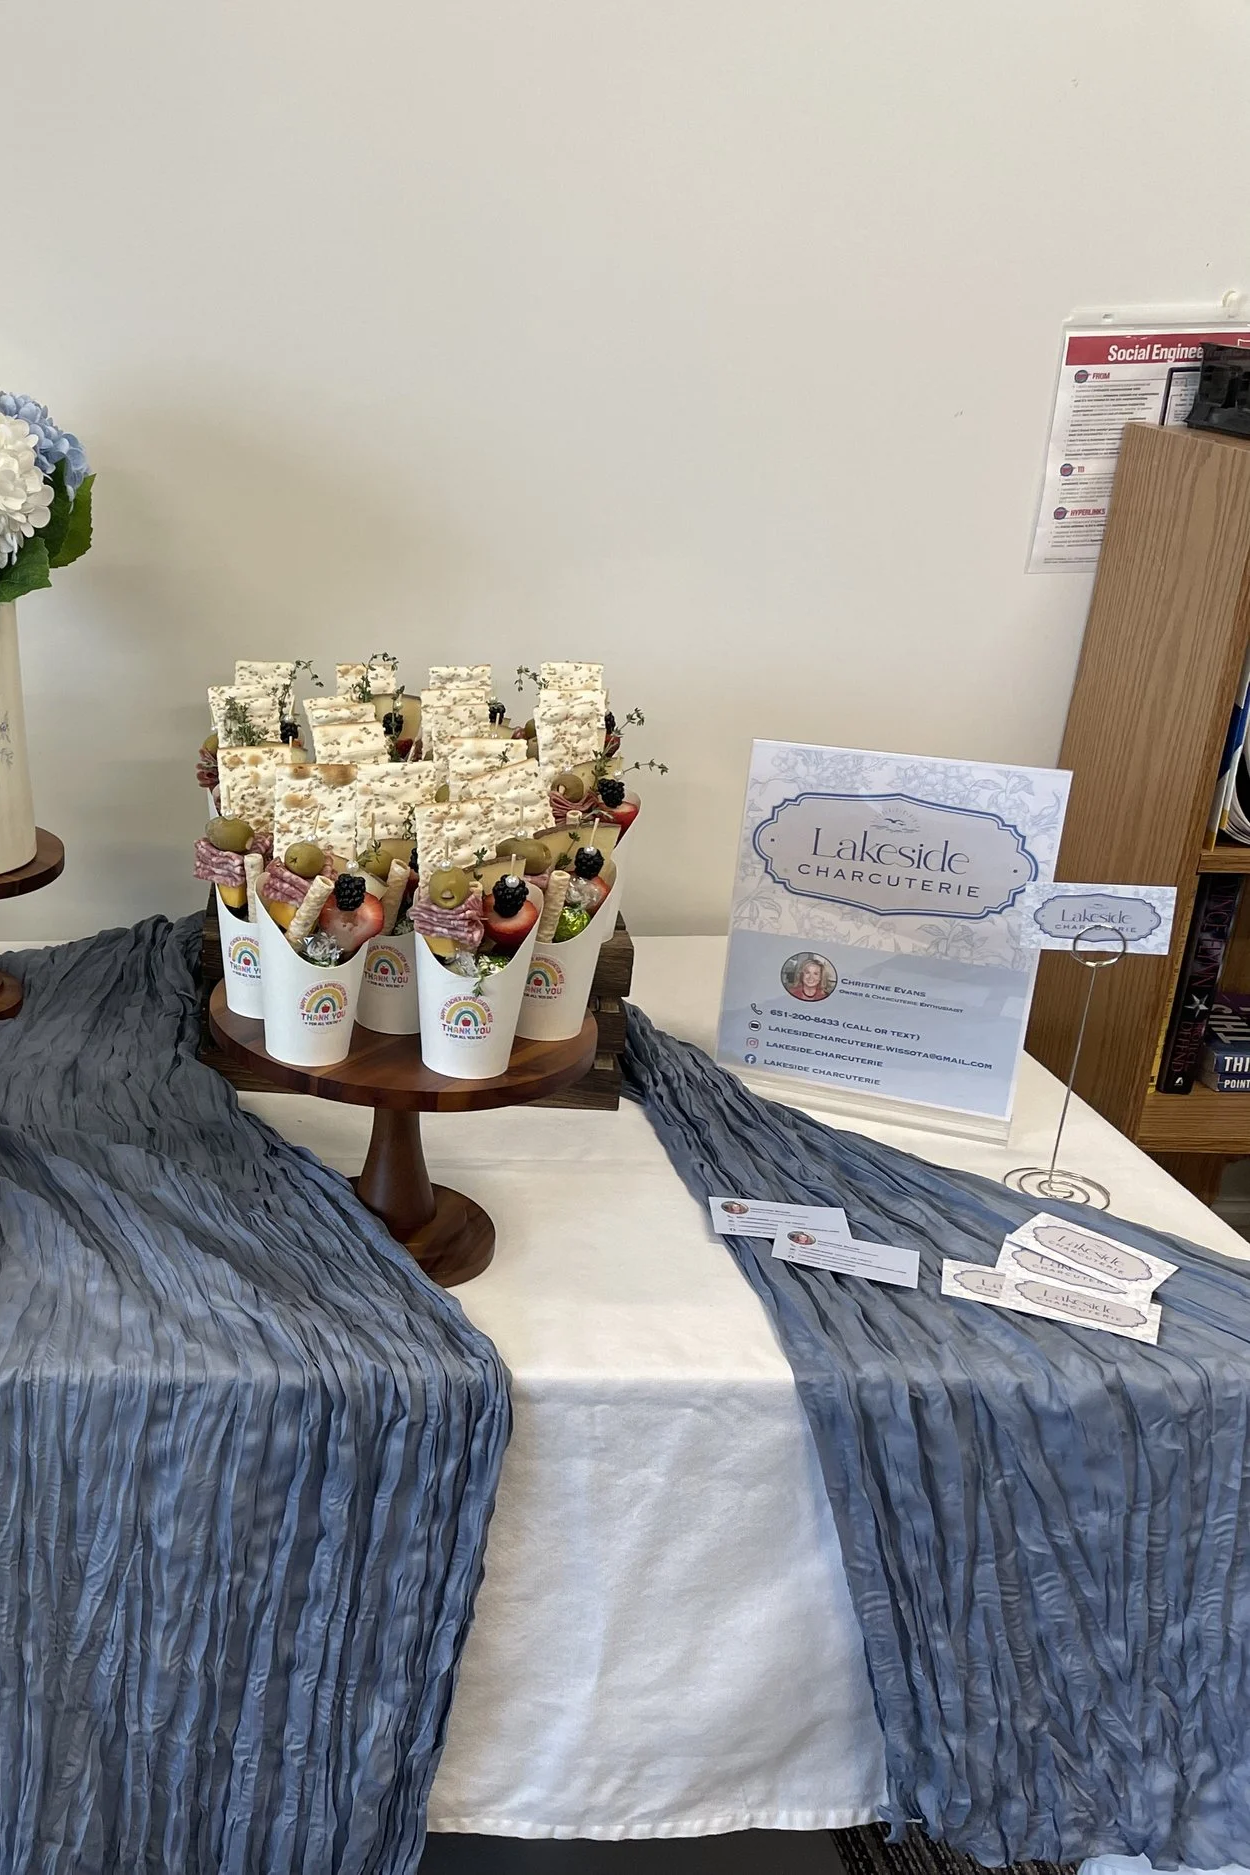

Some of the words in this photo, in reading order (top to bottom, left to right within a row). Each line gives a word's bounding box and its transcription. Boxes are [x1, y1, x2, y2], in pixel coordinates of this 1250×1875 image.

[1108, 344, 1151, 361] Social
[1152, 343, 1204, 362] Enginee
[811, 827, 970, 875] Lakeside
[798, 864, 980, 898] CHARCUTERIE
[1061, 909, 1132, 924] Lakeside
[525, 986, 542, 994] ANK
[442, 1023, 470, 1034] THANK
[474, 1027, 491, 1035] YOU
[770, 1009, 839, 1027] 651-200-8433
[842, 1021, 872, 1033] (CALL
[874, 1027, 888, 1035] OR
[891, 1030, 920, 1041] TEXT)
[766, 1041, 883, 1067] LAKESIDE.CHARCUTERIE
[769, 1025, 992, 1070] LAKESIDECHARCUTERIE.WISSOTA@GMAIL.COM
[764, 1059, 810, 1073] LAKESIDE
[812, 1067, 881, 1085] CHARCUTERIE
